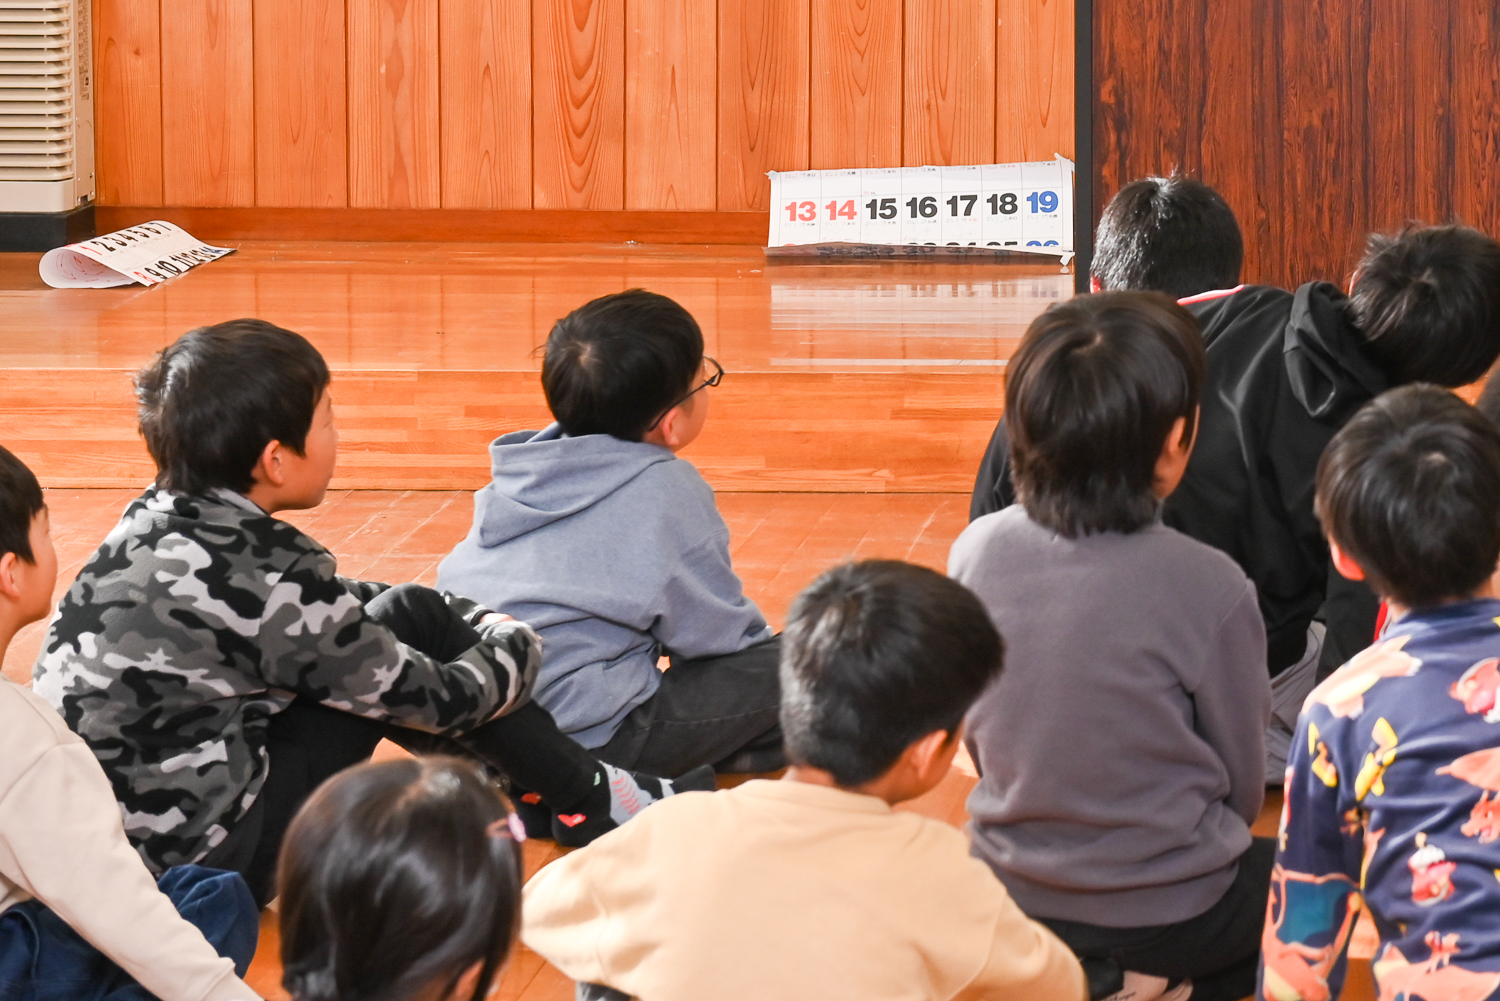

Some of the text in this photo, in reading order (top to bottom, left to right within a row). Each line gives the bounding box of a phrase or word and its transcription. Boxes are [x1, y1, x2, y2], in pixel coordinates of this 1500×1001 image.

[785, 190, 1059, 222] 13 14 15 16 17 18 19
[115, 232, 139, 242] 4
[125, 229, 150, 238] 5
[90, 241, 117, 252] 2
[102, 237, 128, 247] 3
[144, 267, 168, 279] 9
[154, 260, 182, 276] 10
